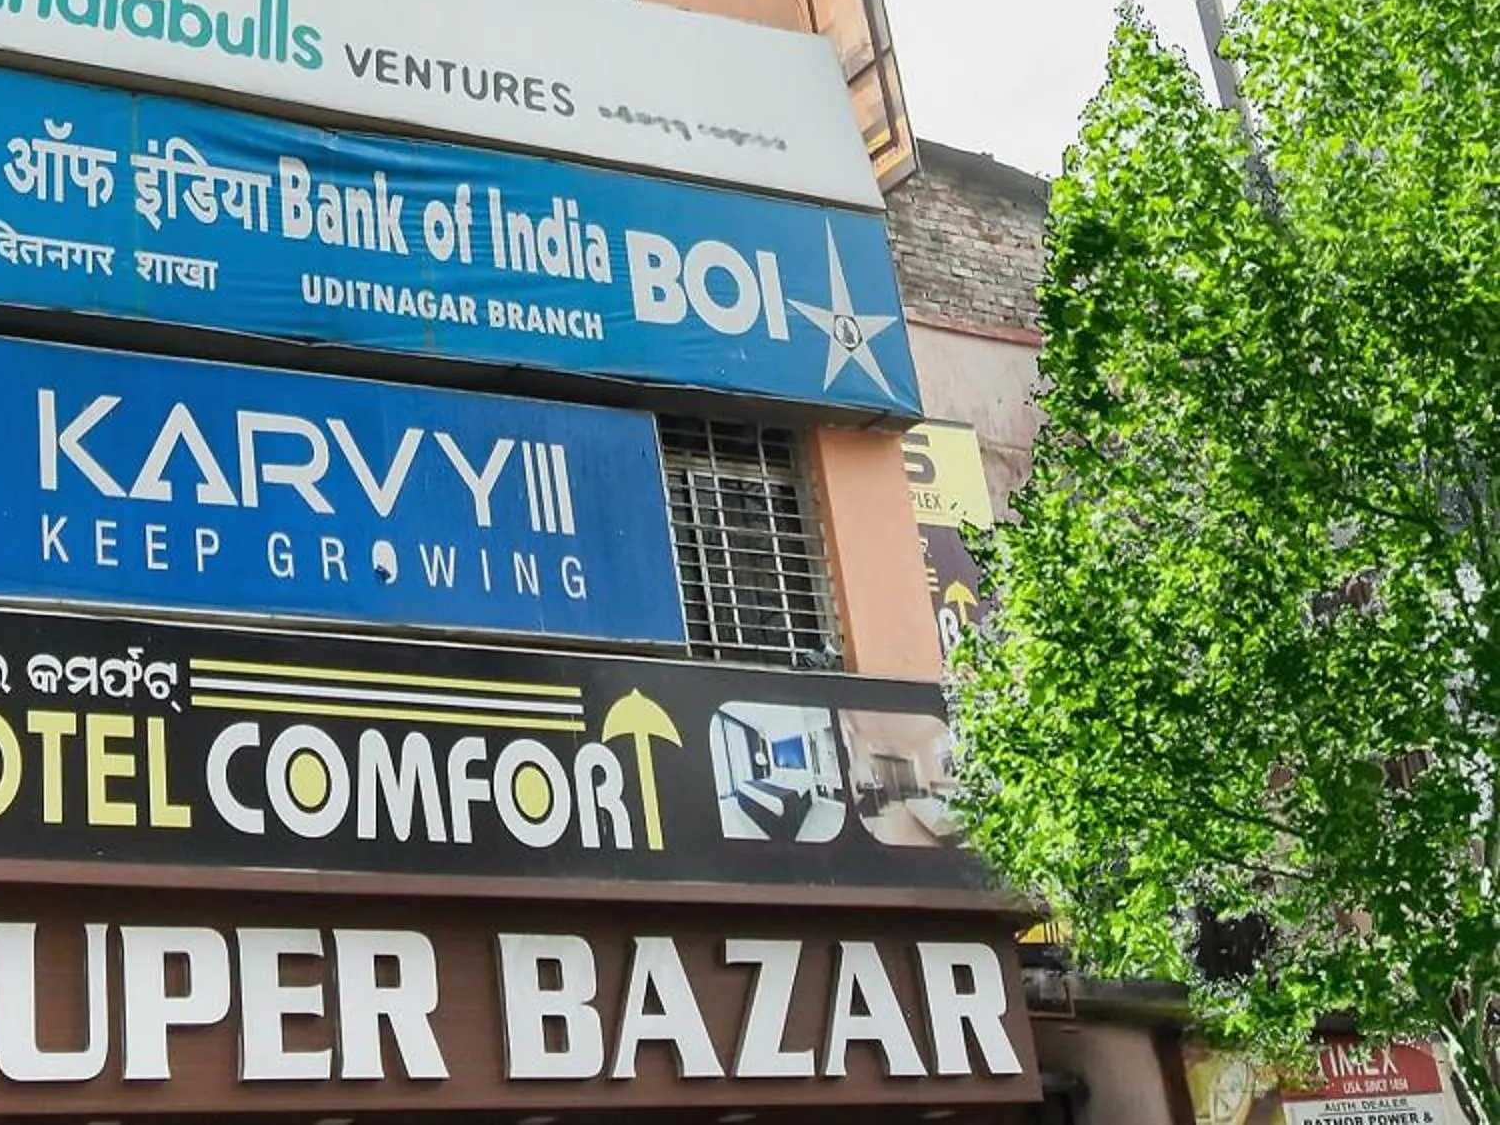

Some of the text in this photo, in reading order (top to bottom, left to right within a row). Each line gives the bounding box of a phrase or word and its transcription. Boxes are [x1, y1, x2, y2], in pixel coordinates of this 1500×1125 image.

[344, 42, 576, 118] VENTURES
[3, 118, 117, 208] ऑफ
[129, 136, 272, 232] इंडिया
[278, 154, 613, 284] Bank of India
[133, 248, 219, 291] शाखा
[301, 273, 605, 341] UDITNAGAR BRANCH
[624, 228, 791, 342] BOI
[37, 387, 514, 529] KARVY
[40, 514, 588, 600] KEEP GROWING
[206, 687, 683, 851] COMFORT
[496, 933, 1023, 1080] BAZAR
[1367, 1111, 1420, 1125] POWER
